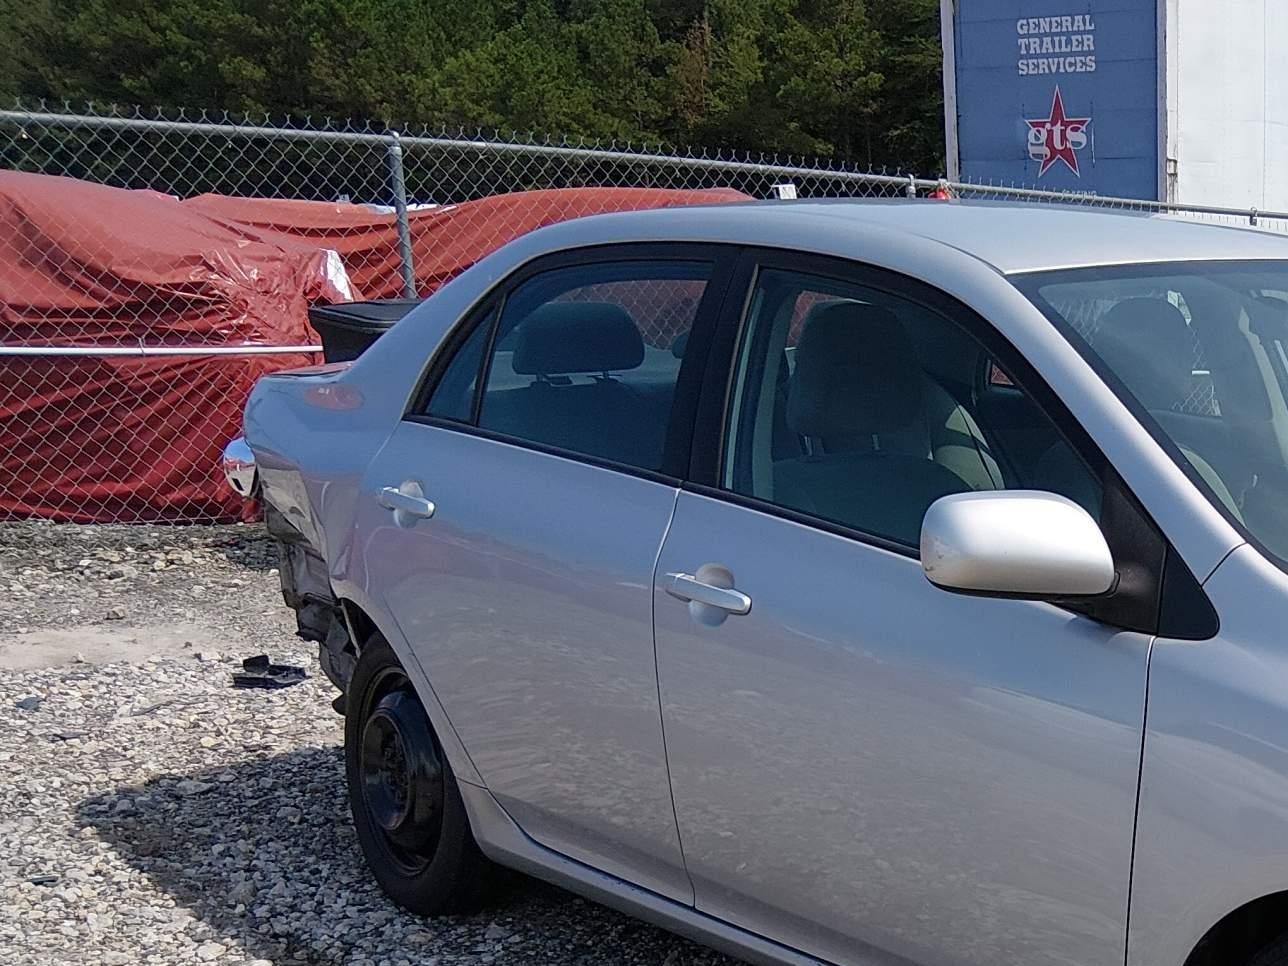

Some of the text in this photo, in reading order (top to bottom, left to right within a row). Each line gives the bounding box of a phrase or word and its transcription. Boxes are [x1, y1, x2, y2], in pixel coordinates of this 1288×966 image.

[1016, 15, 1095, 35] GENERAL
[1017, 34, 1095, 55] TRAILER
[1018, 55, 1096, 76] SERVICES
[1027, 120, 1088, 162] gts
